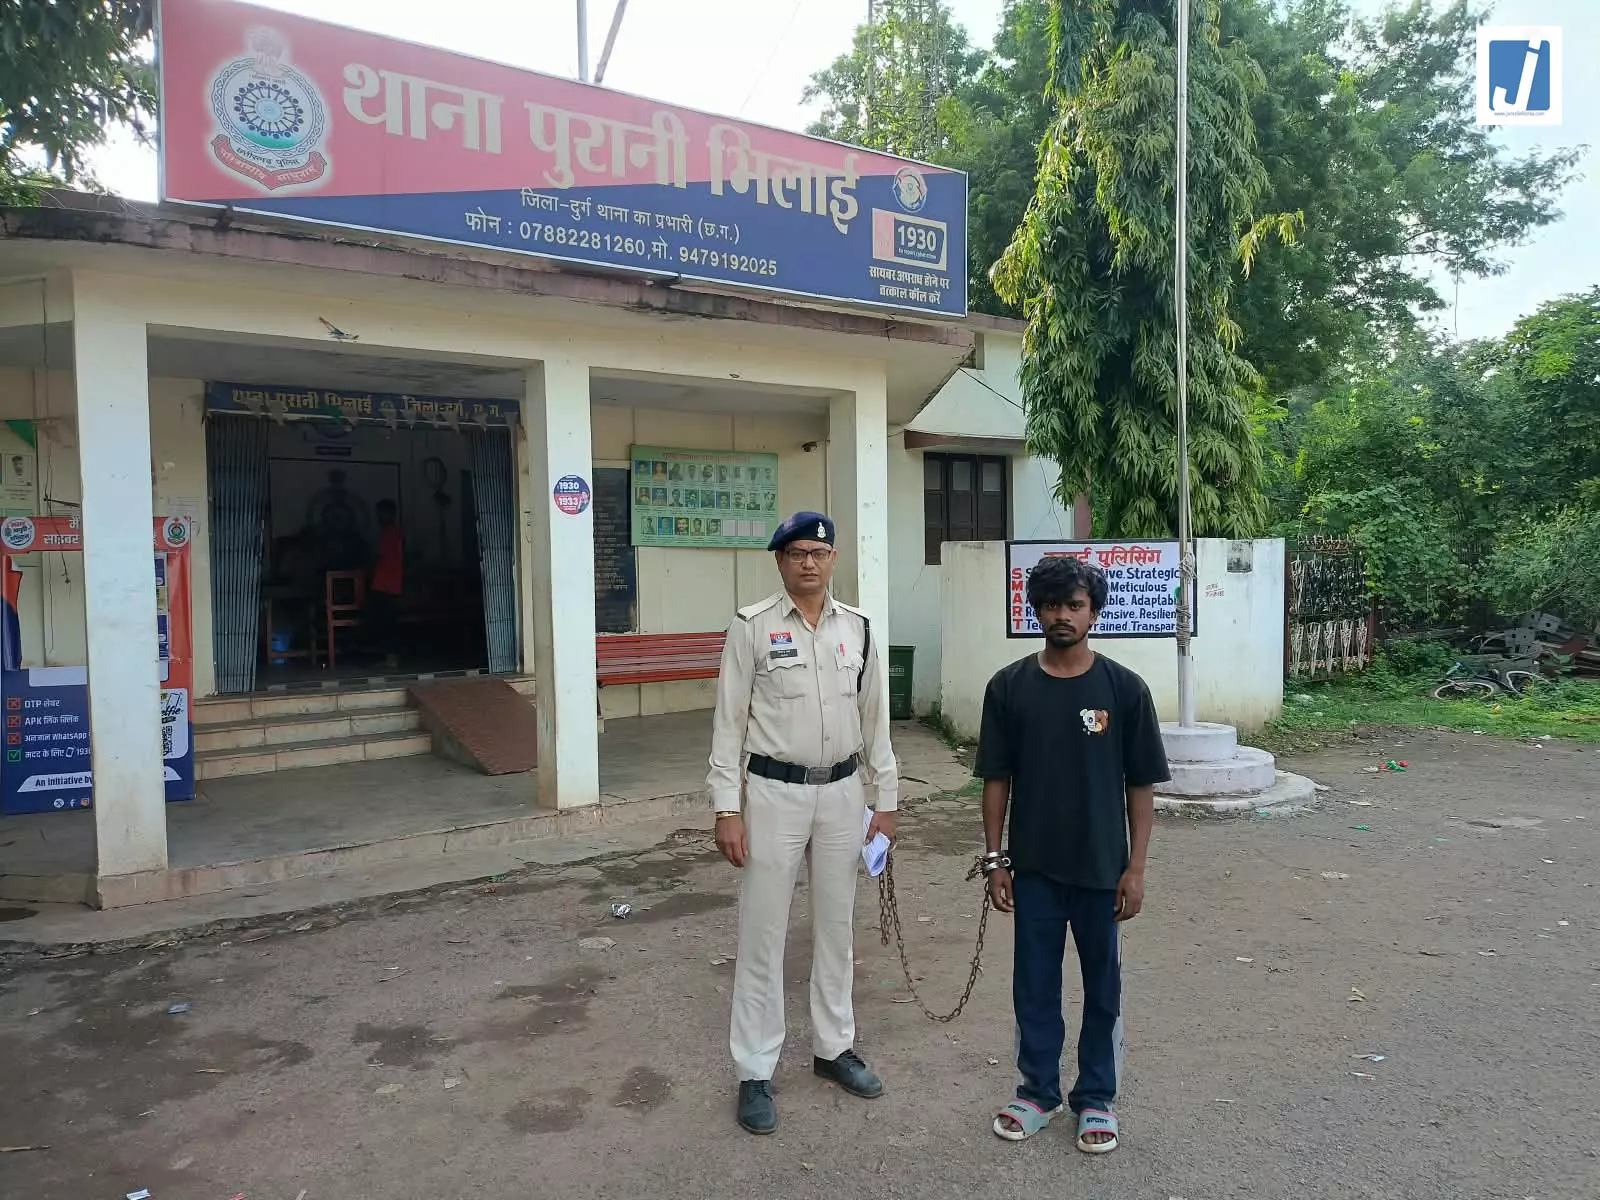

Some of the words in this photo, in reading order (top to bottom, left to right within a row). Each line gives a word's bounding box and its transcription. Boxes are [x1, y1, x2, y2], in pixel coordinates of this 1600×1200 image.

[343, 62, 505, 154] थाना
[523, 100, 690, 190] पुरानी
[708, 124, 861, 235] भिलाई
[520, 186, 592, 221] जिला-दुर्ग
[597, 204, 629, 223] थाना
[633, 210, 651, 227] का
[655, 213, 693, 234] प्रभारी
[698, 217, 740, 245] (छ.ग.)
[465, 207, 501, 235] फोन
[679, 246, 777, 276] 9479192025
[898, 225, 937, 252] 1930
[940, 278, 951, 290] पर
[559, 481, 580, 490] 1930
[1096, 546, 1161, 568] पुलिसिंग
[1110, 581, 1168, 593] Meticulous
[1139, 608, 1177, 619] Resilien
[1131, 621, 1176, 632] Transpar
[25, 700, 42, 709] OTP
[25, 717, 42, 726] APK
[52, 732, 87, 741] WhatsApp
[35, 778, 46, 787] An
